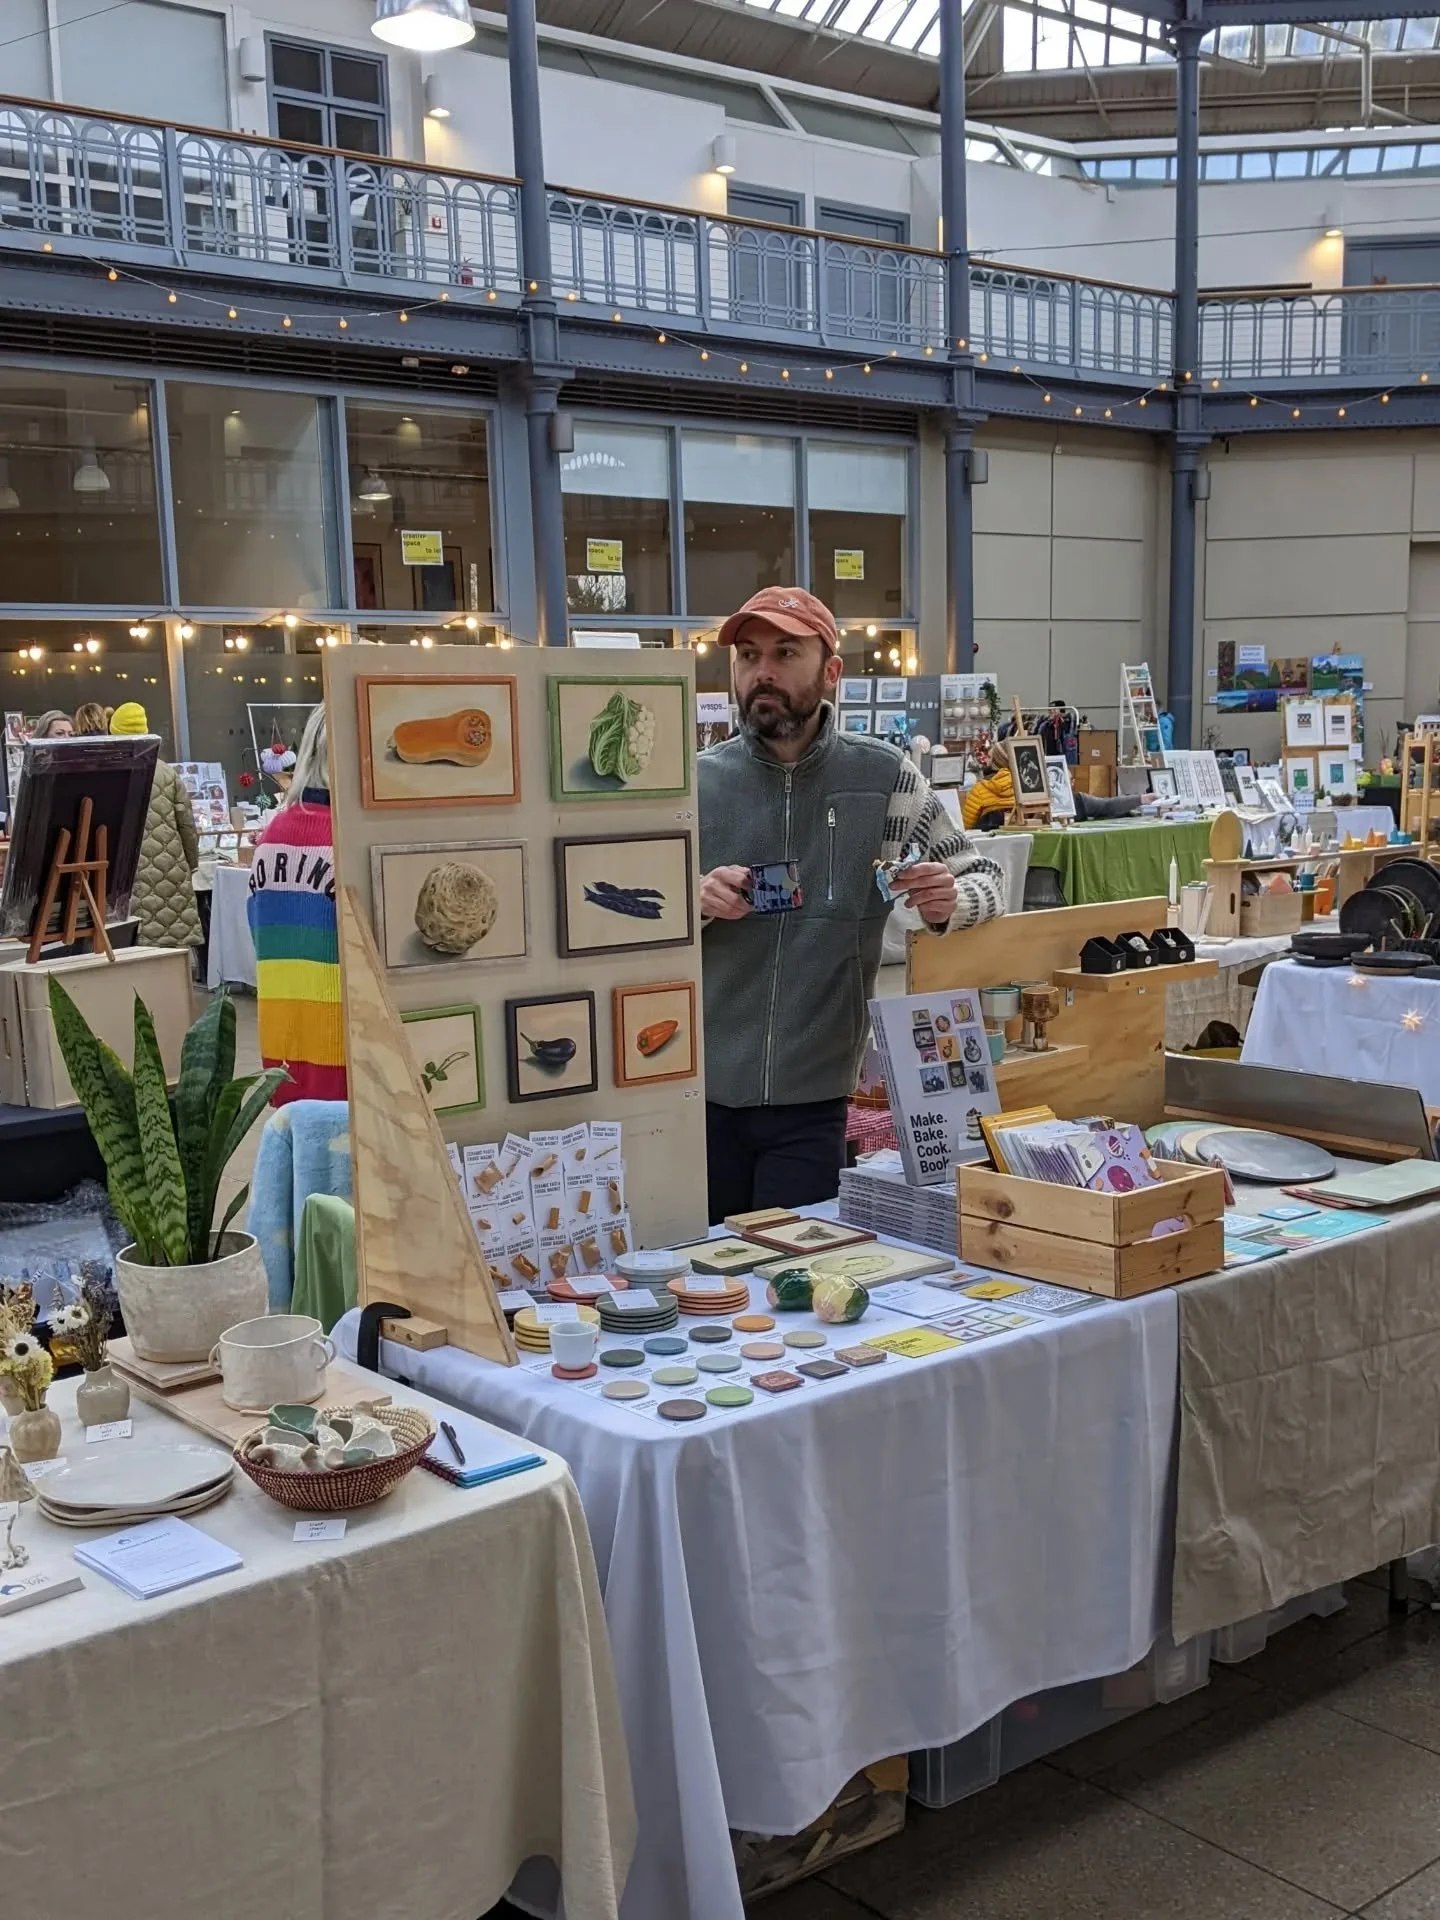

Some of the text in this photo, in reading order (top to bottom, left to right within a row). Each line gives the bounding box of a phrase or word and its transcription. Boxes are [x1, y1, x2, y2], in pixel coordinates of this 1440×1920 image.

[910, 1112, 947, 1128] Make.
[913, 1128, 948, 1143] Bake.
[917, 1141, 952, 1158] Cook.
